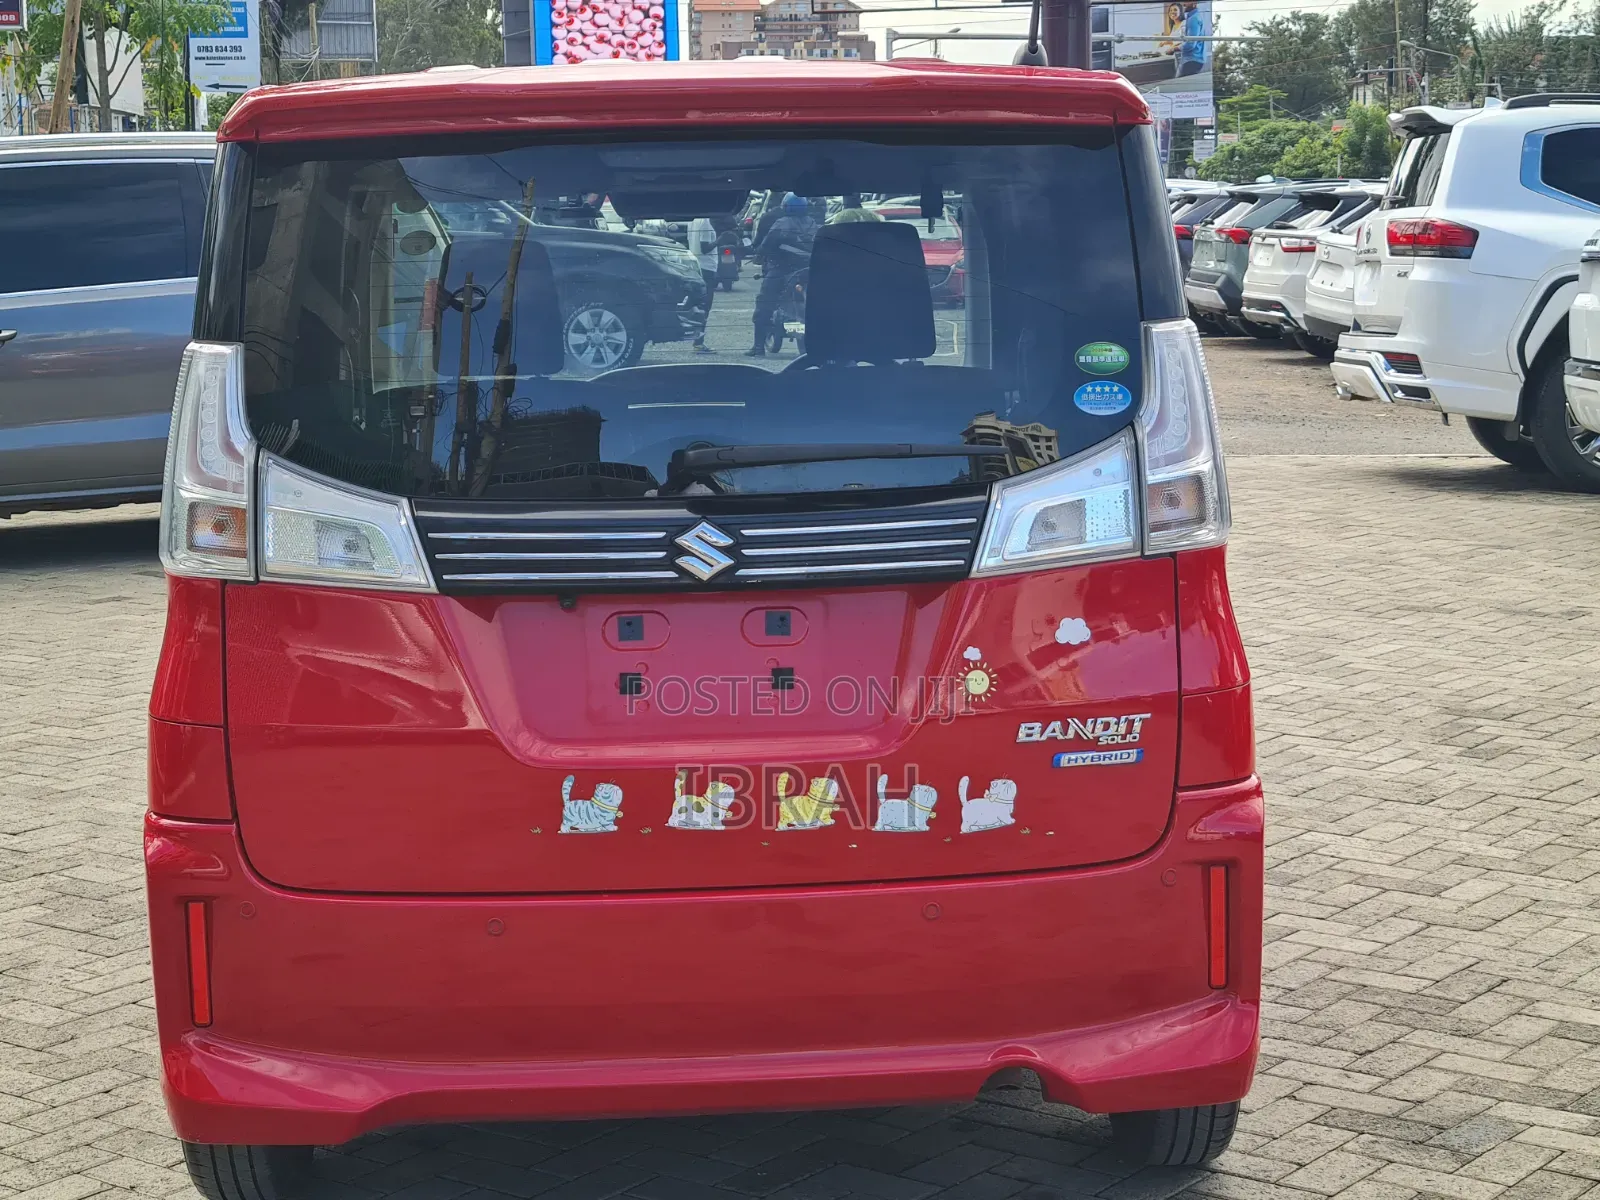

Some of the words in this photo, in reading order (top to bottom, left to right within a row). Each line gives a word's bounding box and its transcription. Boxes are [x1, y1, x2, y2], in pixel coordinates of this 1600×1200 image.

[1016, 713, 1152, 742] BANDIT
[1098, 733, 1140, 745] SOLIO
[1066, 751, 1132, 764] HYBRID
